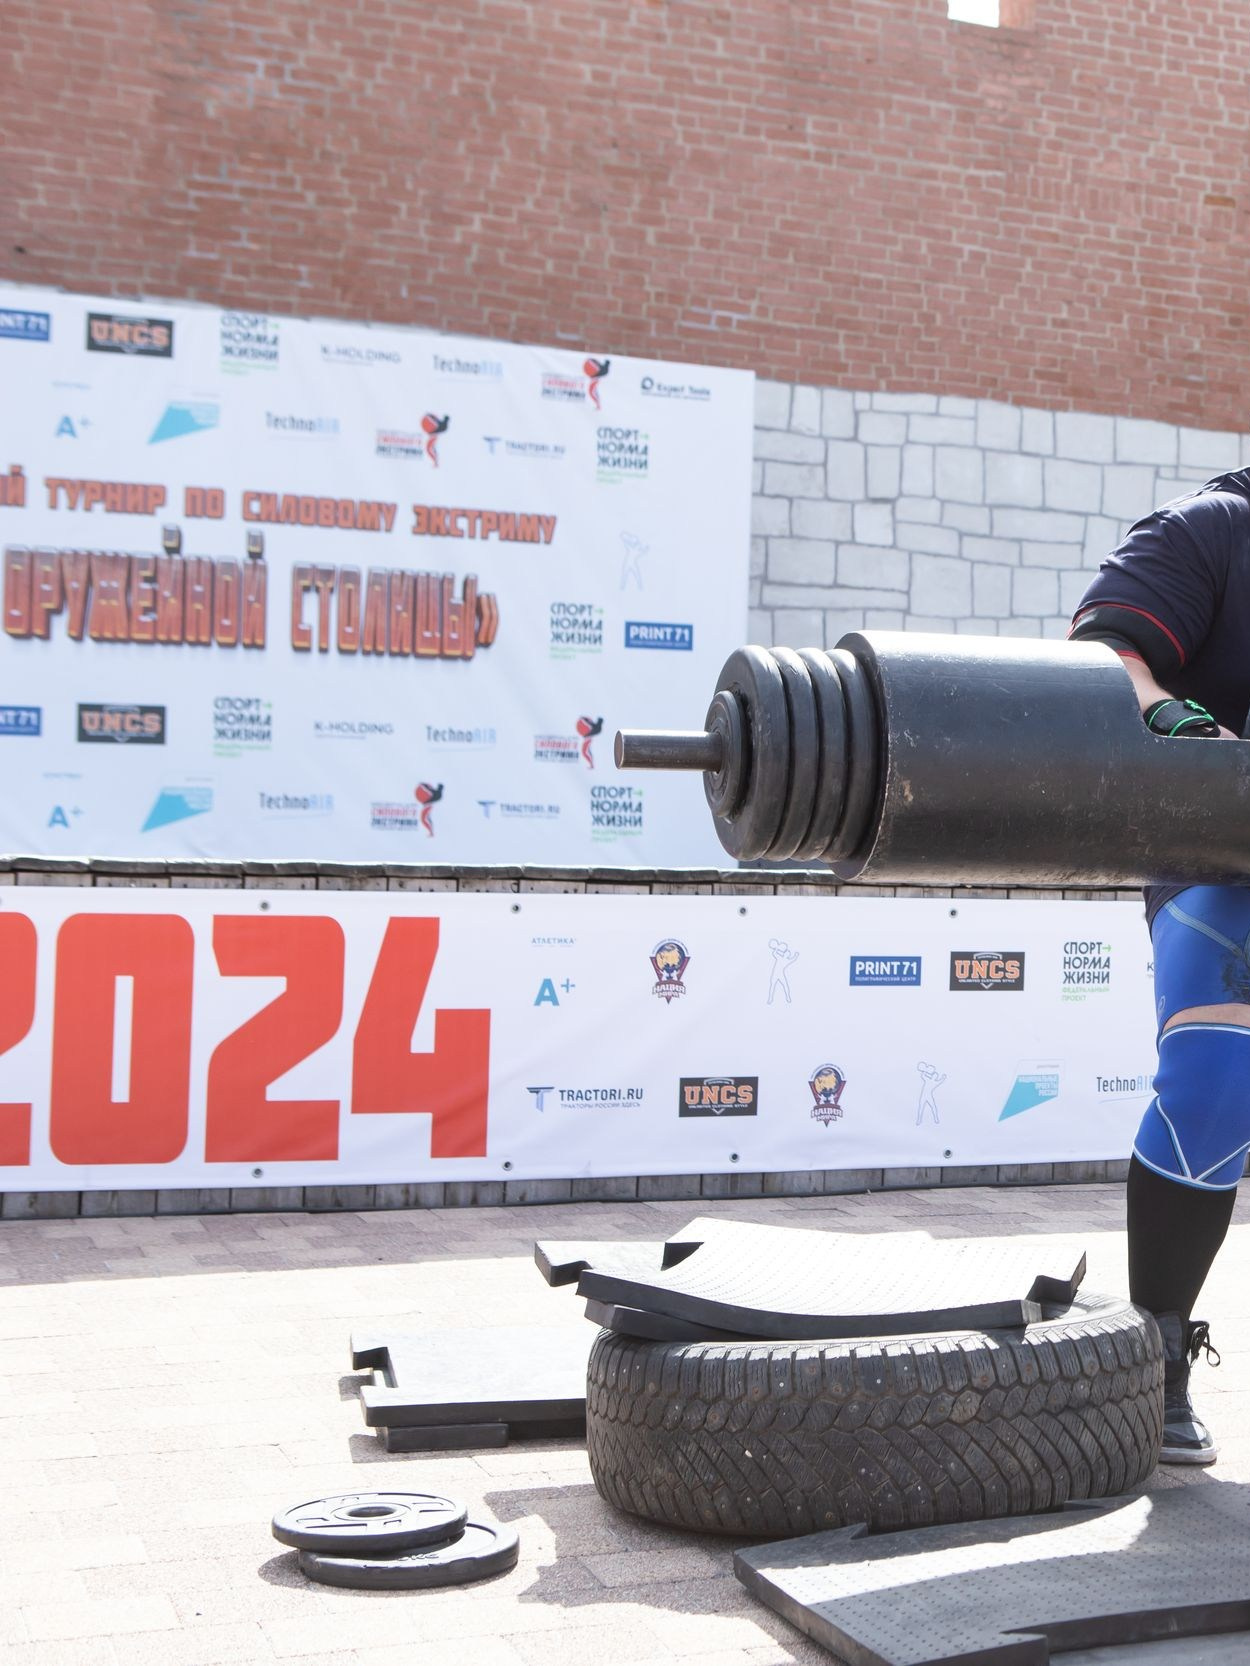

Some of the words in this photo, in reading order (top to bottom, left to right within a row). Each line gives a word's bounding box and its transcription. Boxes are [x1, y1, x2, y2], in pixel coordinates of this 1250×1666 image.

[90, 320, 171, 348] UNCS
[597, 426, 640, 441] СПОРТ
[597, 440, 648, 455] НОРМА
[597, 456, 648, 470] ЖИЗНИ
[44, 477, 166, 516] ТУРНИР
[184, 486, 225, 519] ПО
[242, 490, 397, 533] СИЛОВОМУ
[411, 504, 557, 545] ЭКСТРИМУ
[3, 524, 268, 650] ОРУЖЕЙНОЙ
[550, 602, 594, 617] СПОРТ
[550, 617, 603, 631] НОРМА
[550, 631, 603, 645] ЖИЗНИ
[630, 625, 672, 641] PRINT
[673, 627, 690, 642] 71
[214, 696, 262, 712] СПОРТ
[81, 711, 162, 733] UNCS
[426, 725, 497, 744] TechnoAIR
[590, 786, 634, 799] СПОРТ
[590, 799, 643, 814] НОРМА
[590, 814, 643, 828] ЖИЗНИ
[1063, 941, 1103, 955] СПОРТ
[855, 961, 900, 976] PRINT
[902, 961, 917, 976] 71
[954, 959, 1021, 979] UNCS
[1063, 956, 1111, 970] НОРМА
[1063, 971, 1110, 985] ЖИЗНИ
[0, 912, 491, 1167] 024
[559, 1087, 644, 1102] TRACTORI.RU
[684, 1084, 754, 1105] UNCS
